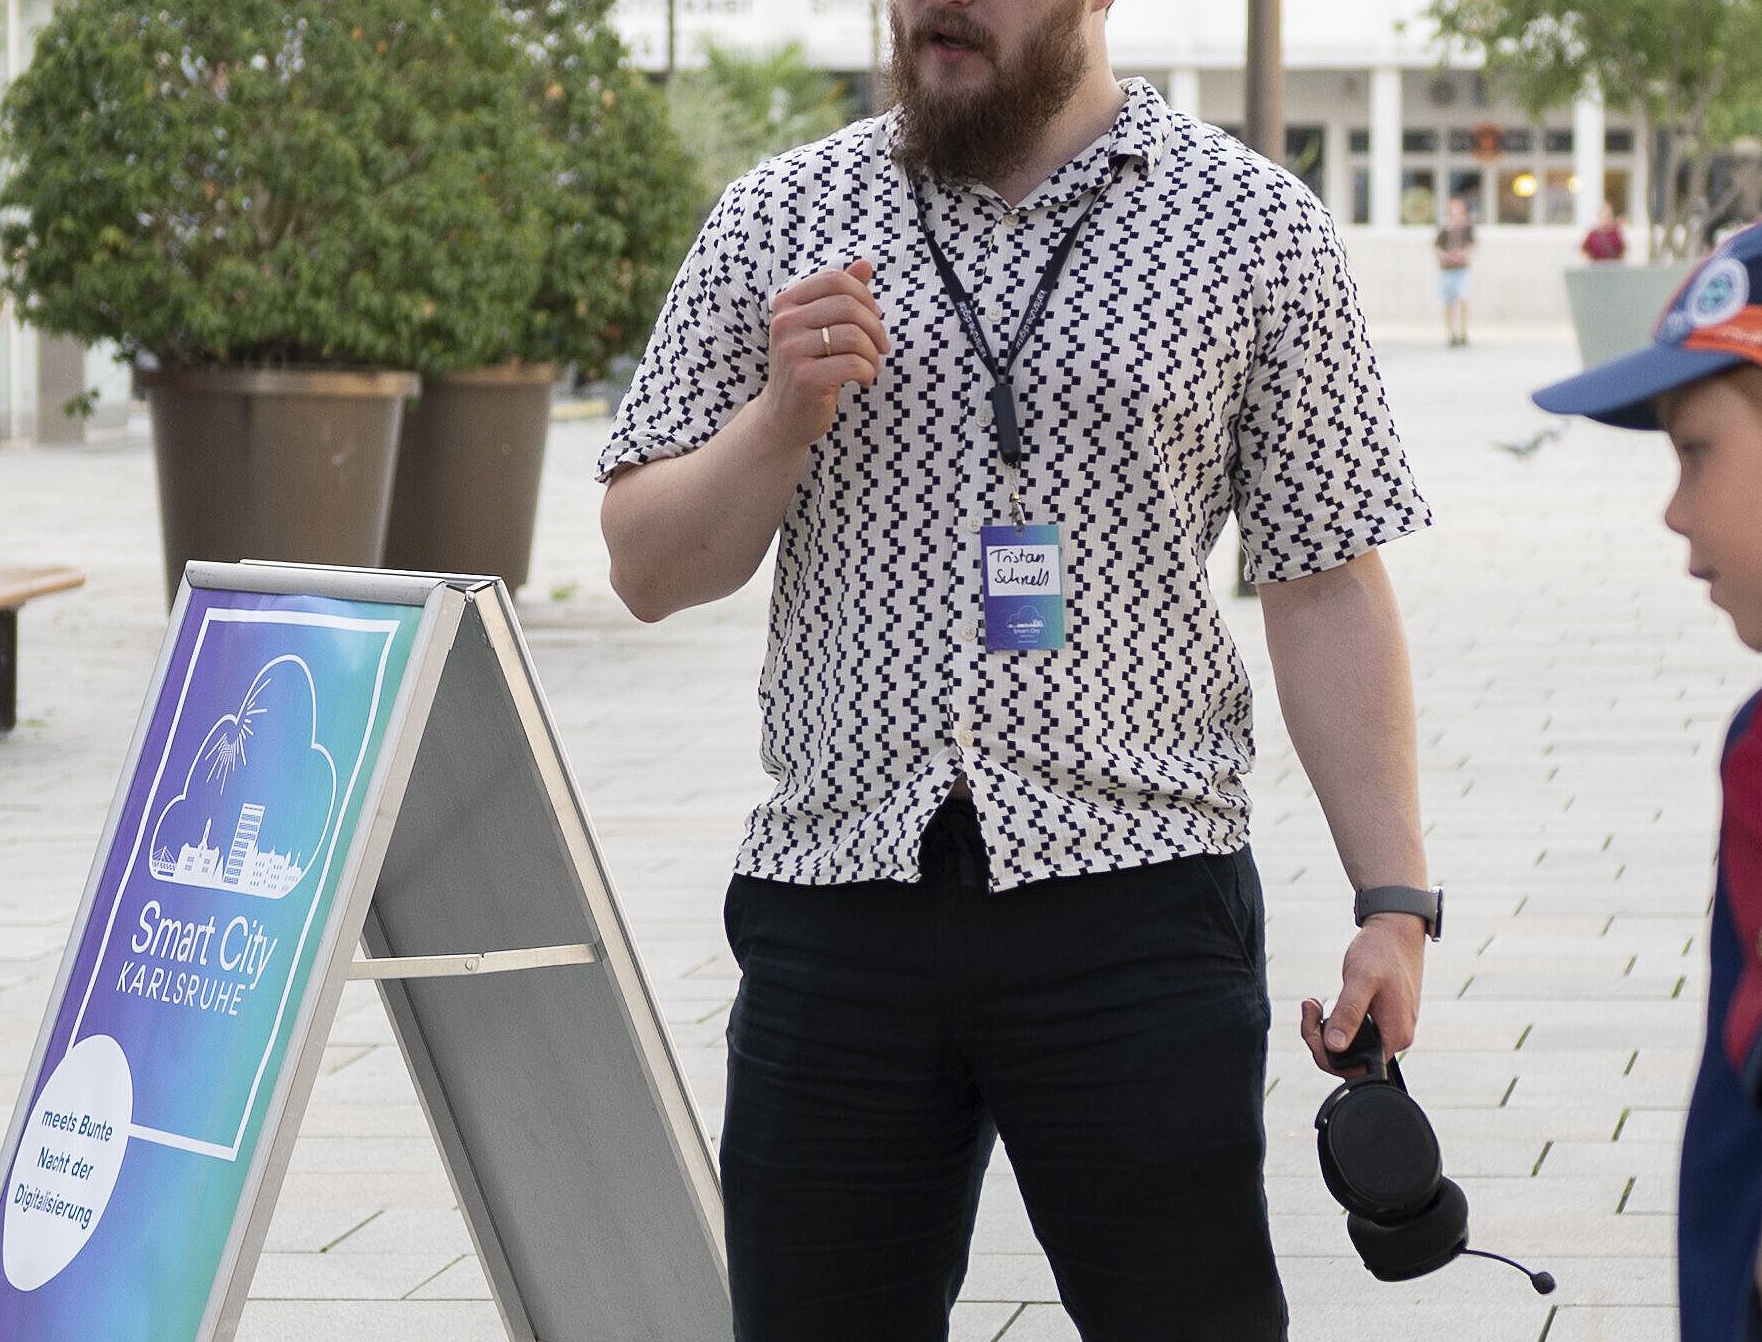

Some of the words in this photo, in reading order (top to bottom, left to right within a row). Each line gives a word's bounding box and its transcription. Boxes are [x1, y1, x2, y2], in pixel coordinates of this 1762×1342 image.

[988, 547, 1046, 565] Tristan
[131, 899, 216, 965] Smart
[219, 914, 278, 989] City
[115, 960, 247, 1017] KARLSRUHE
[40, 1109, 78, 1134] meets
[77, 1113, 114, 1143] Bunte
[36, 1145, 70, 1174] Nacht
[71, 1159, 95, 1182] der
[13, 1182, 94, 1230] Digitalisierung
